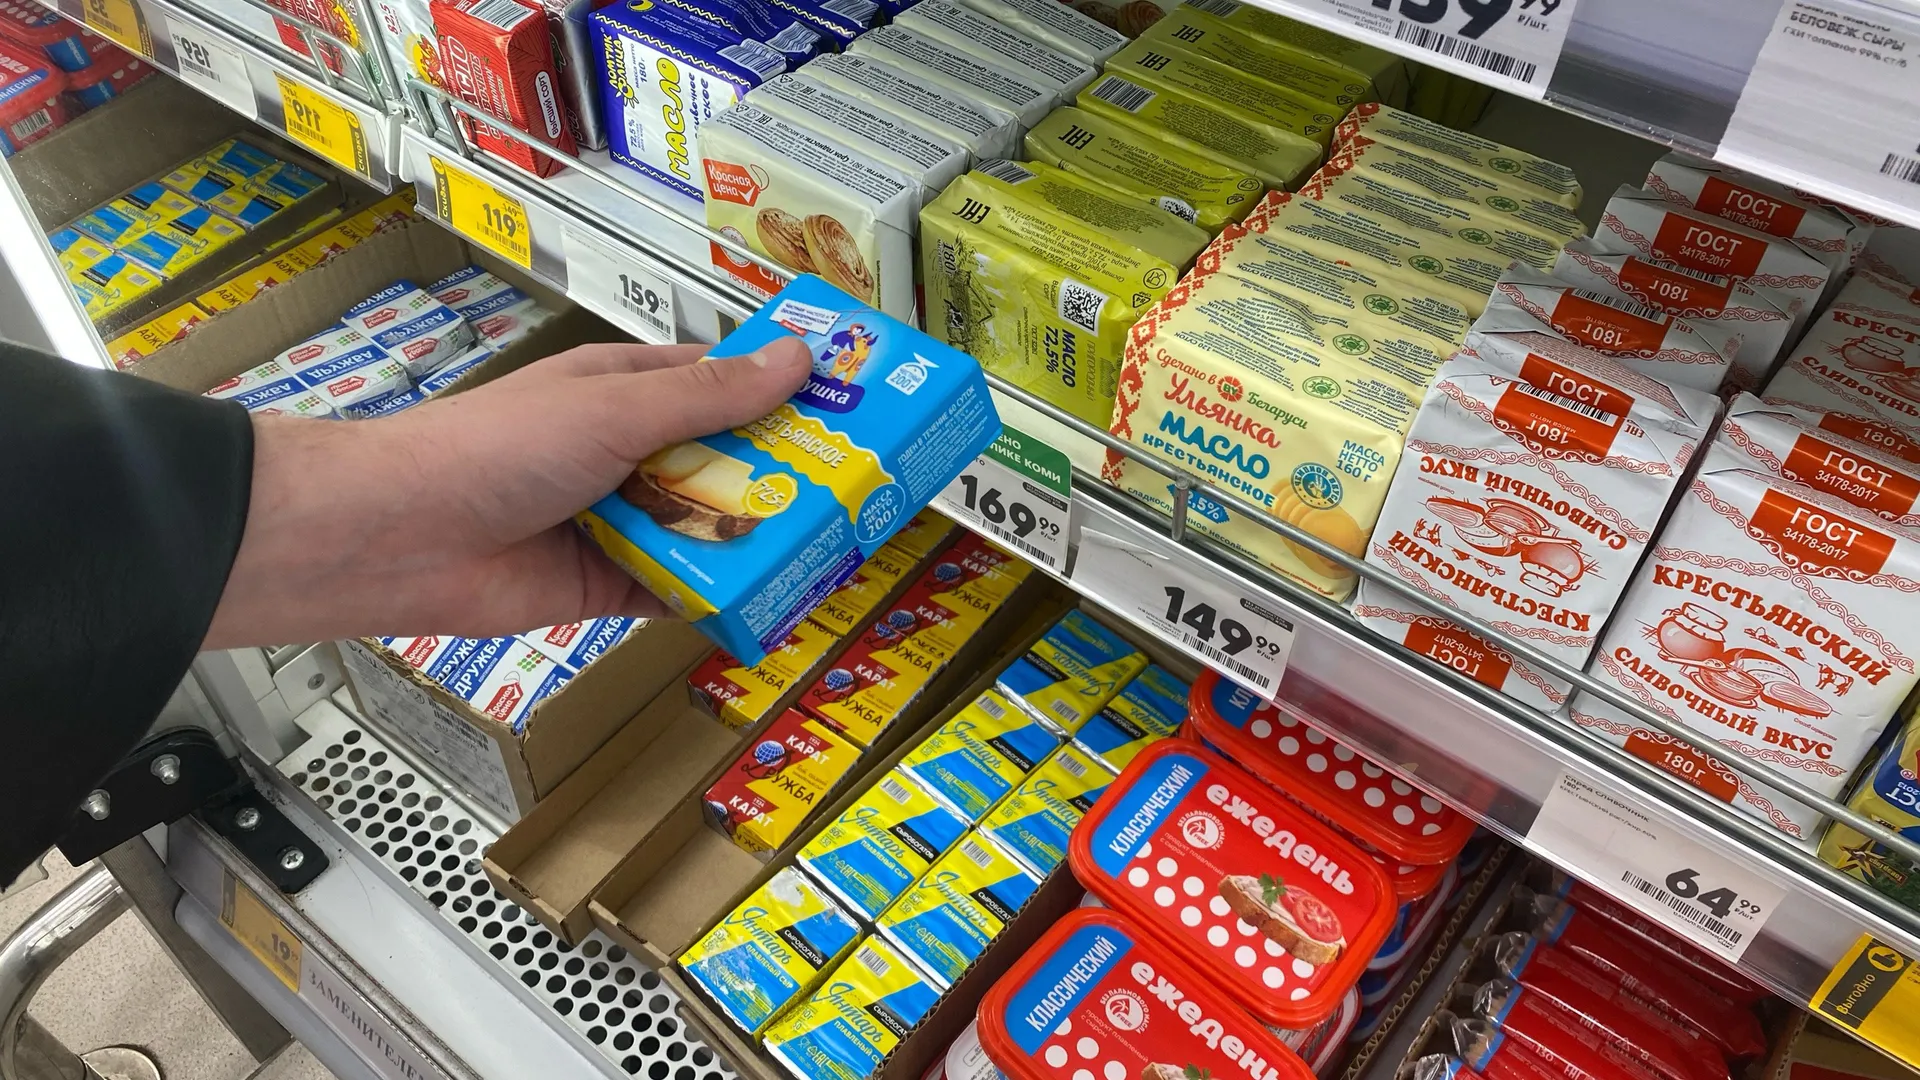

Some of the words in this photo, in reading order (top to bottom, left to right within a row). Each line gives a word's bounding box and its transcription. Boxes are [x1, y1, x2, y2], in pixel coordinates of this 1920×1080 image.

[1790, 10, 1906, 52] БЕЛОВЕЖ.СЫРЫ
[538, 76, 550, 99] СОРТ
[656, 57, 690, 180] МАСЛО
[708, 164, 752, 189] Красная
[712, 183, 739, 198] цена
[885, 177, 905, 191] Масса
[482, 203, 517, 237] 119
[1719, 208, 1770, 231] 34178-2017
[1724, 189, 1782, 220] ГОСТ
[1684, 226, 1742, 256] ГОСТ
[1678, 246, 1732, 269] 34178-2017
[618, 274, 662, 313] 159
[1045, 326, 1060, 372] 72,5%
[1173, 330, 1198, 346] СУТОК
[1061, 329, 1077, 388] МАСЛО
[1156, 348, 1207, 382] Сделано
[1208, 374, 1218, 386] в
[1246, 391, 1308, 430] Беларуси
[1546, 371, 1608, 406] ГОСТ
[898, 442, 919, 464] ГОДЕН
[923, 411, 949, 440] ТЕЧЕНИЕ
[956, 385, 975, 406] СУТОК
[1163, 372, 1281, 449] Ульянка
[1160, 410, 1270, 480] МАСЛО
[1343, 439, 1385, 466] МАССА
[1024, 459, 1061, 483] КОМИ
[1143, 433, 1275, 508] КРЕСТЬЯНСКОЕ
[1336, 459, 1362, 479] 160
[1364, 474, 1372, 483] г
[1338, 450, 1378, 473] НЕТТО
[1420, 455, 1480, 484] ВКУС
[1822, 451, 1892, 488] ГОСТ
[1814, 470, 1880, 502] 34178-2017
[862, 490, 892, 519] МАССА
[865, 496, 896, 526] НЕТТО:
[960, 475, 1036, 538] 169
[1485, 467, 1628, 551] СЛИВОЧНЫЙ
[867, 510, 891, 538] 200
[1039, 517, 1060, 536] 99
[1790, 507, 1864, 548] ГОСТ
[1782, 527, 1849, 561] 34178-2017
[961, 558, 1001, 581] КАРАТ
[1388, 529, 1592, 632] КРЕСТЬЯНСКИЙ
[915, 605, 956, 631] КАРАТ
[1164, 586, 1253, 656] 149
[1652, 564, 1893, 687] КРЕСТЬЯНСКИЙ
[558, 632, 574, 648] цена
[1256, 635, 1281, 656] 99
[1433, 634, 1484, 661] 34178-2017
[412, 649, 427, 668] цена
[453, 636, 505, 698] ДРУЖБА
[1424, 646, 1480, 677] ГОСТ
[854, 664, 897, 691] КАРАТ
[488, 684, 514, 714] Красная
[498, 698, 514, 720] цена
[704, 681, 746, 709] КАРАТ
[1614, 646, 1759, 738] СЛИВОЧНЫЙ
[1764, 725, 1833, 761] ВКУС
[785, 734, 830, 765] КАРАТ
[940, 720, 1002, 769] Янтарь
[1663, 750, 1694, 773] 180
[728, 795, 774, 828] КАРАТ
[1108, 762, 1195, 859] КЛАССИЧЕСКИЙ
[840, 806, 904, 860] Янтарь
[1206, 783, 1356, 895] ежедень
[919, 870, 990, 928] Янтарь
[1665, 868, 1738, 919] 64
[1739, 898, 1761, 916] 99
[725, 906, 790, 965] Янтарь
[1024, 934, 1118, 1033] КЛАССИЧЕСКИЙ
[1836, 974, 1876, 1015] Выгодно
[811, 982, 885, 1045] Янтарь
